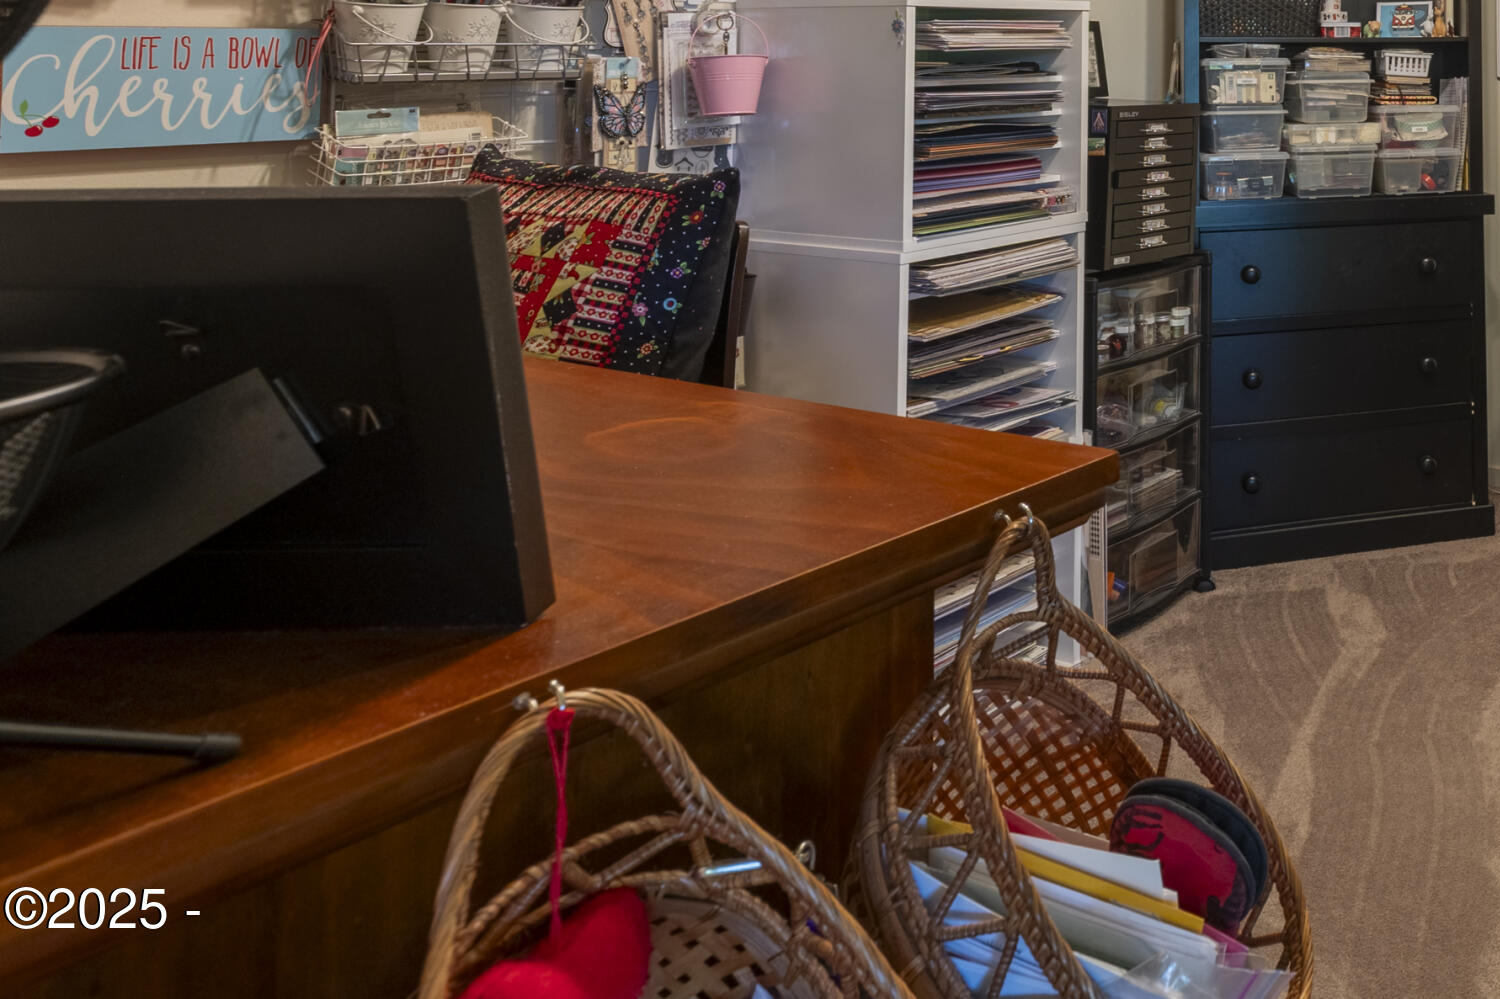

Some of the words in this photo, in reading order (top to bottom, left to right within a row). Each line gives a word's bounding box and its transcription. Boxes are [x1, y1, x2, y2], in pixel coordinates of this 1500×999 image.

[2, 34, 319, 137] Cherries
[120, 36, 163, 70] LIFE
[172, 36, 192, 71] IS
[201, 36, 216, 70] A
[228, 36, 284, 70] BOWL
